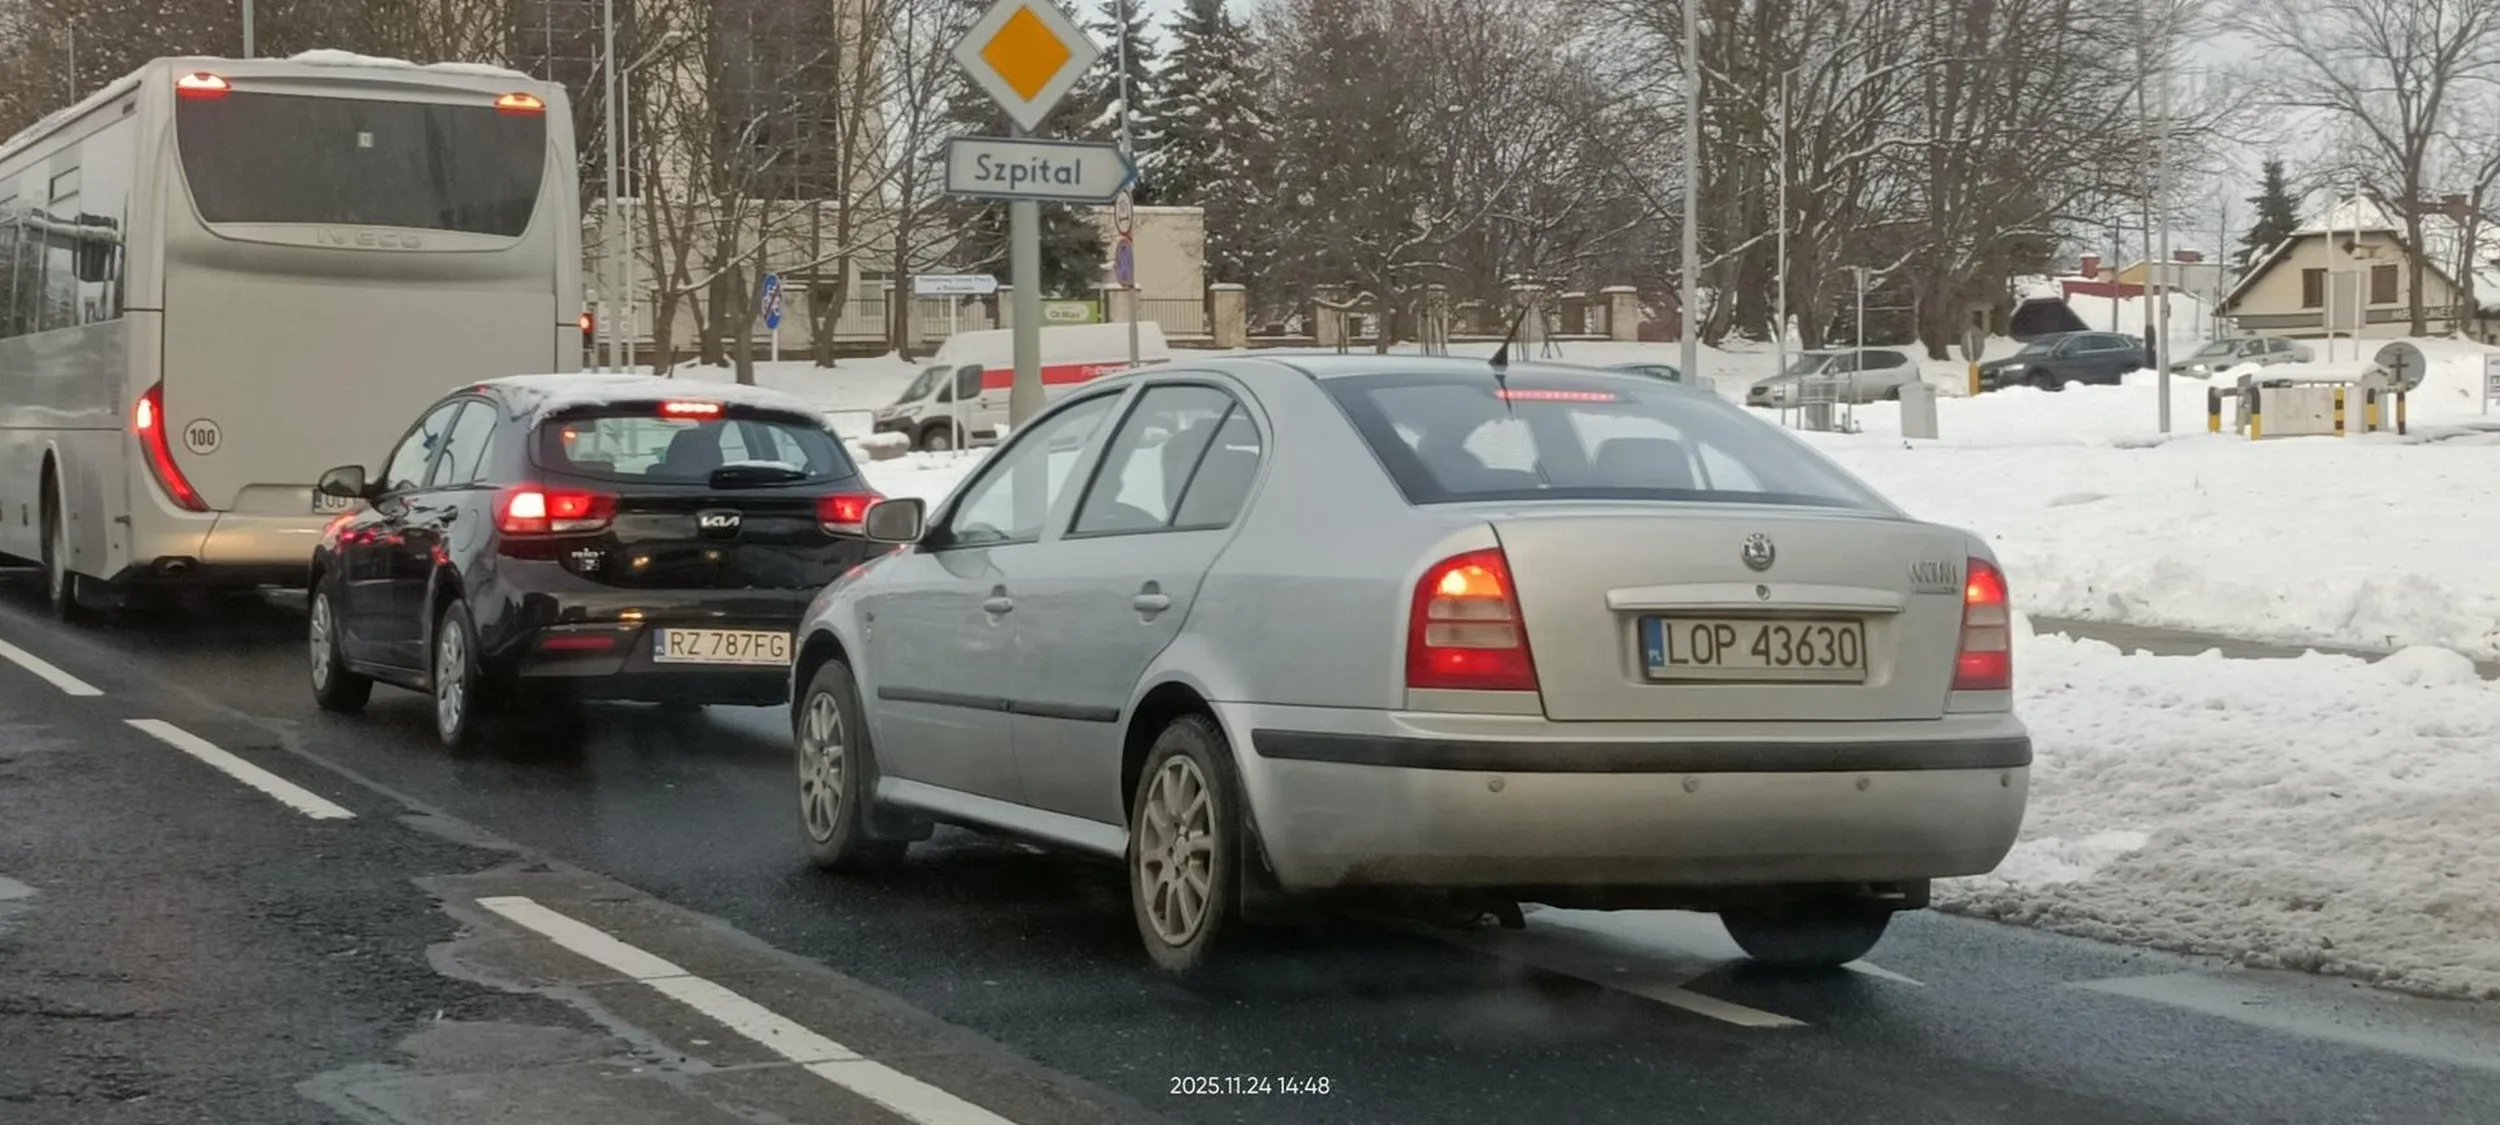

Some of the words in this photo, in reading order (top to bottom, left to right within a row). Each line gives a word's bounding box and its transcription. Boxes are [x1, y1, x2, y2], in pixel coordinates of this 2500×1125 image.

[975, 153, 1081, 190] Szpital
[190, 428, 215, 446] 100
[701, 515, 740, 528] KIA
[670, 632, 701, 655] RZ
[711, 633, 784, 657] 787FG
[1667, 623, 1737, 665] LOP
[1751, 625, 1858, 667] 43630
